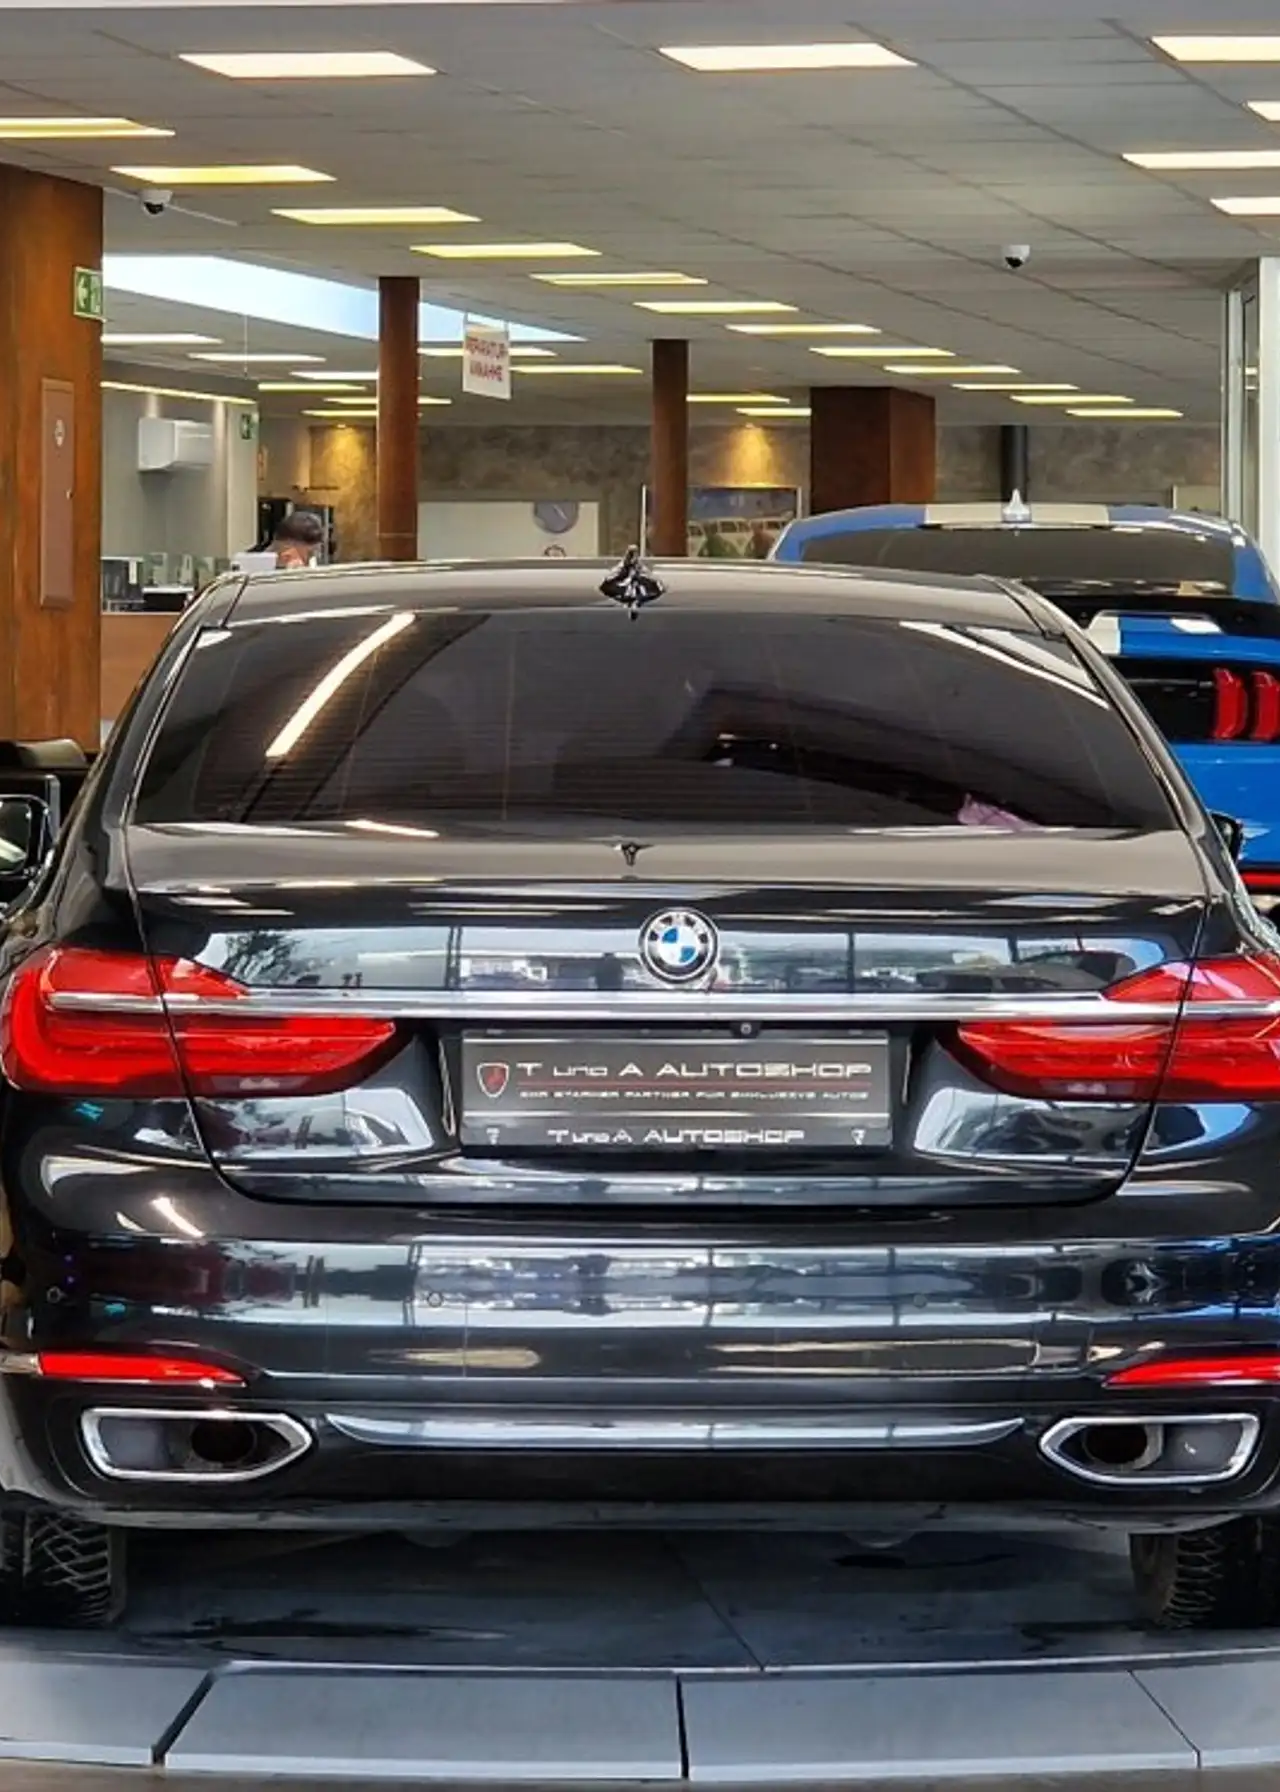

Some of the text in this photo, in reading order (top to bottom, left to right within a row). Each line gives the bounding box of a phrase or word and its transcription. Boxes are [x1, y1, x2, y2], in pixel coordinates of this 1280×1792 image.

[516, 1062, 543, 1077] T
[618, 1062, 645, 1077] A
[656, 1062, 872, 1077] AUTOSHOP
[547, 1129, 569, 1143] T
[612, 1128, 633, 1143] A
[643, 1128, 805, 1143] AUTOSHOP
